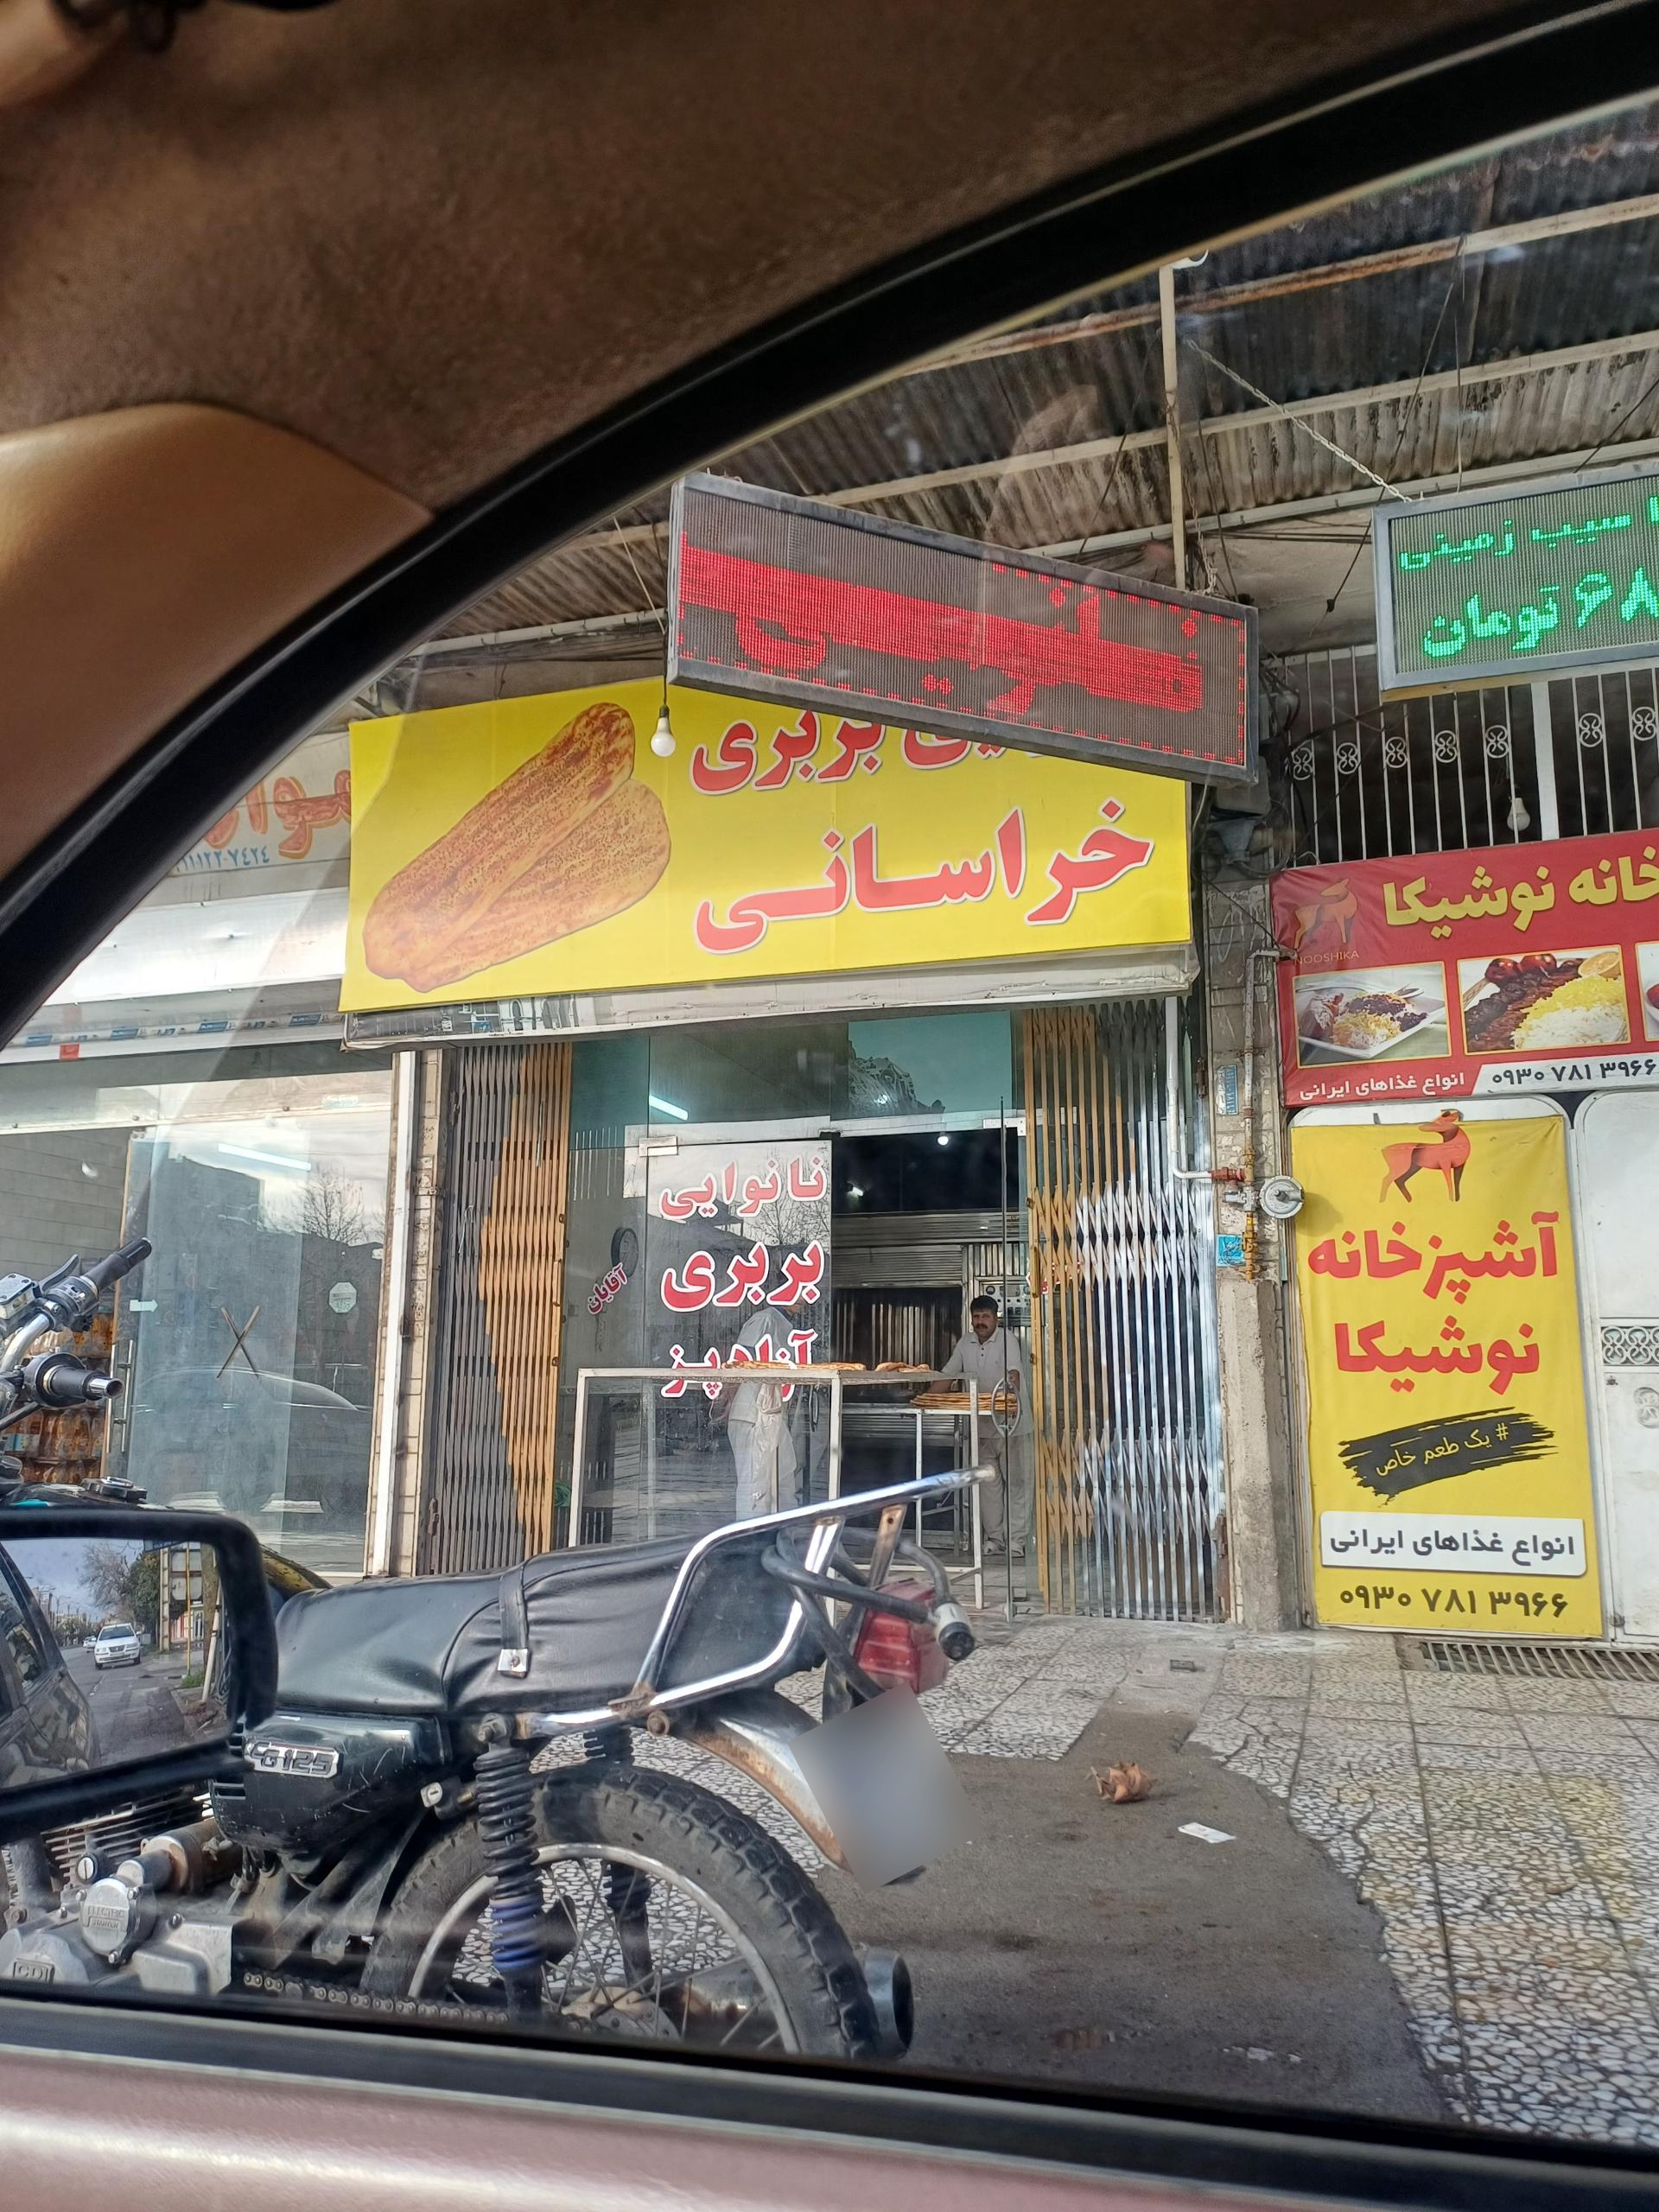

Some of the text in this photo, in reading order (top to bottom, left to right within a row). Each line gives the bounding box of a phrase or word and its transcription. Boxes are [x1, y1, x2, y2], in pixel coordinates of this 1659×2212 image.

[1400, 520, 1515, 571] زمینی
[1532, 514, 1631, 548] سیب
[1423, 585, 1560, 658] تومان
[691, 709, 887, 794] بربری
[693, 798, 1154, 955] خراسانی
[1382, 865, 1555, 939] نوشیکا
[1299, 1071, 1465, 1101] انواع غذاهای ایرانی
[1491, 1058, 1657, 1085] ۰۹۳۰ ۷۸۱ ۳۹۶۶
[659, 1155, 829, 1219] نانوایی
[661, 1240, 825, 1312] بربری
[1307, 1211, 1560, 1305] آشپزخانه
[588, 1262, 628, 1315] آقایان
[1334, 1315, 1541, 1395] نوشیکا
[1376, 1449, 1417, 1477] خاص
[1424, 1436, 1460, 1465] طعم
[1464, 1428, 1493, 1449] یک
[1330, 1529, 1575, 1567] انواع غذاهای ایرانی
[1339, 1585, 1568, 1618] ۰۹۳۰ ۷۸۱ ۳۹۶۶
